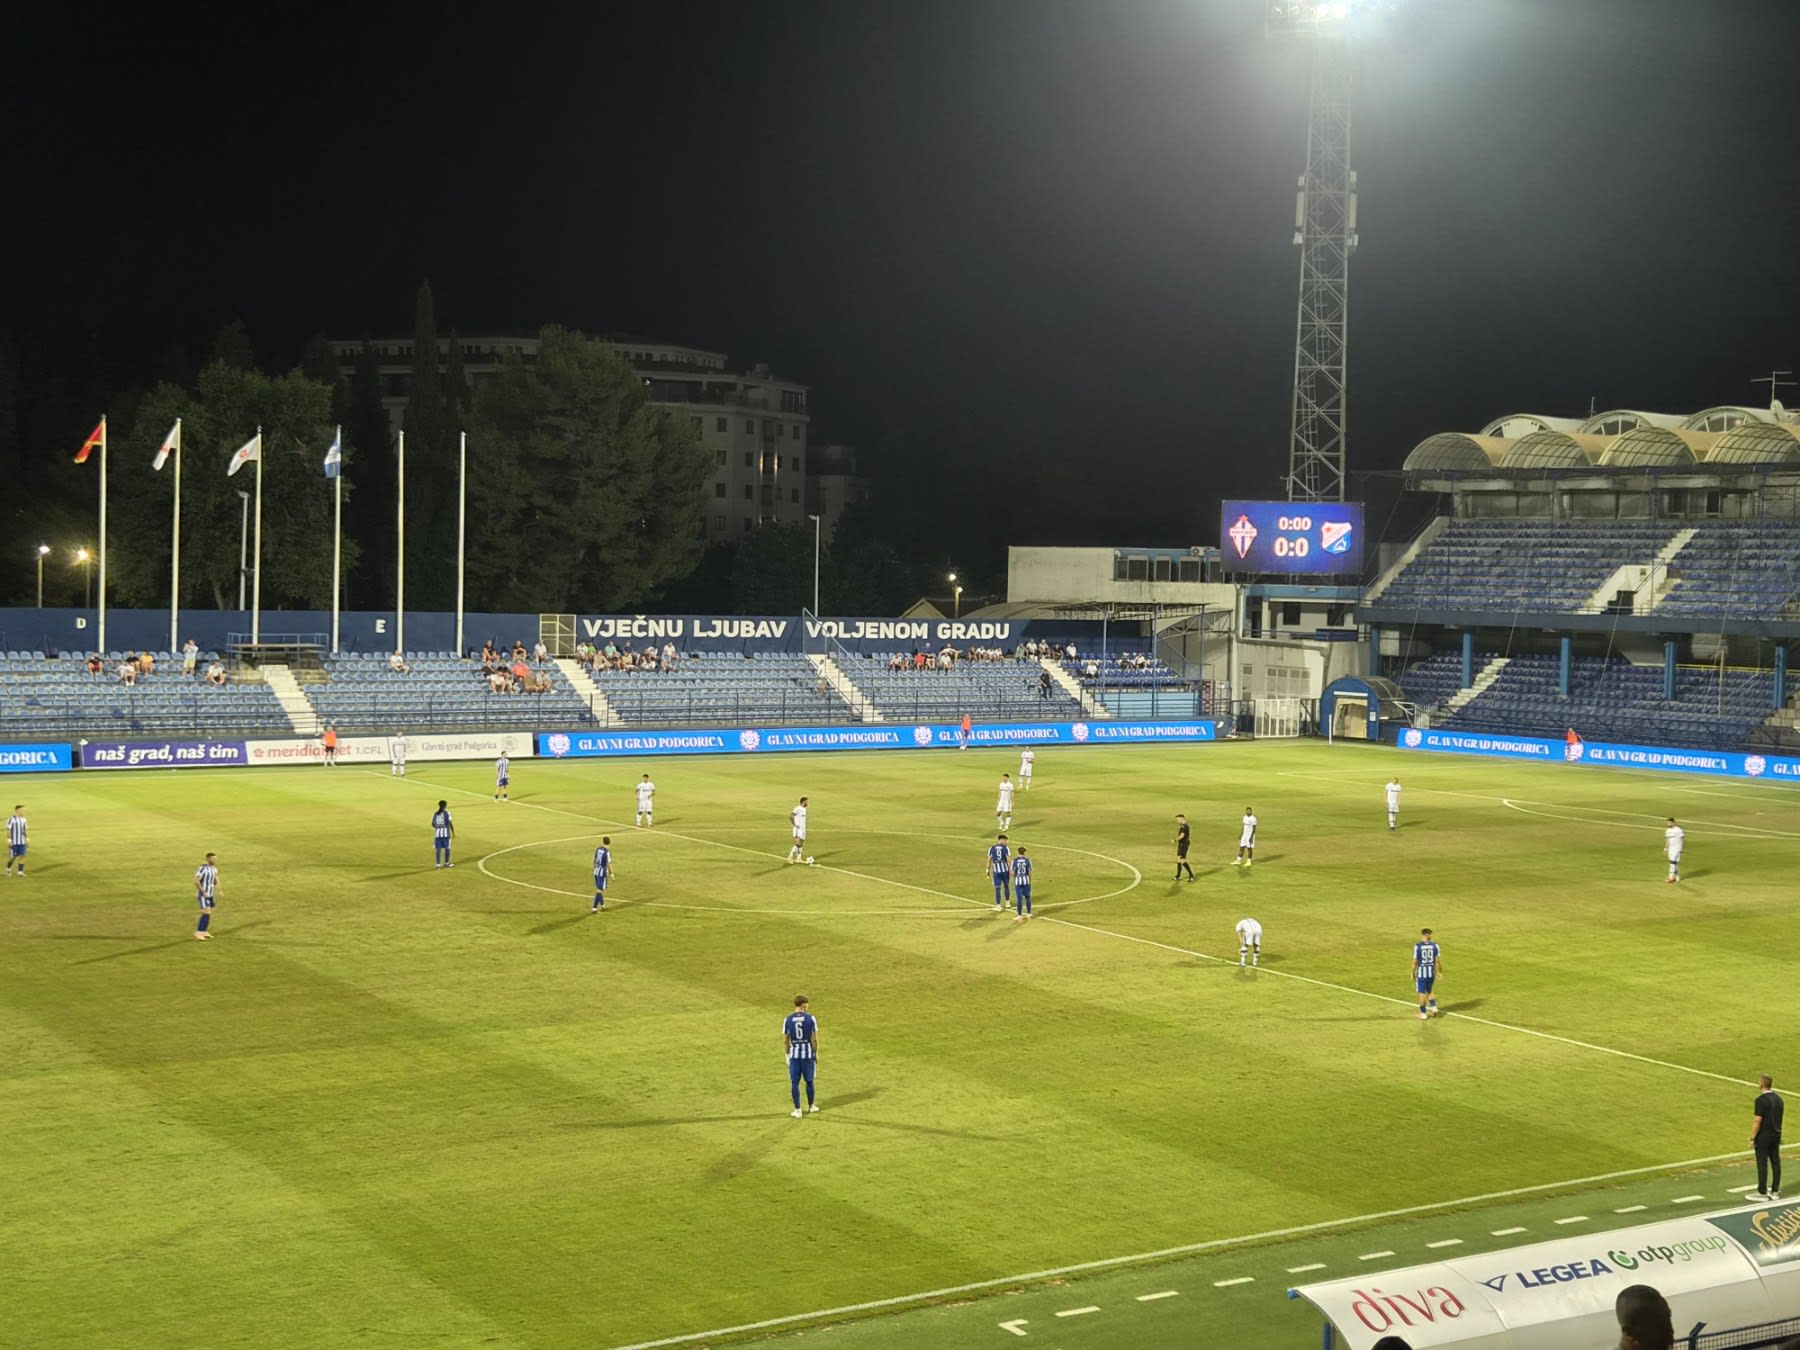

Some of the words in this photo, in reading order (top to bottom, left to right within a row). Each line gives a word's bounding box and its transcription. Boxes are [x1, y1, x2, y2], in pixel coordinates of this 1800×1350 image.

[1279, 517, 1312, 531] 0:00
[1275, 537, 1309, 557] 0:0
[76, 617, 86, 630] D
[376, 619, 386, 633] E
[583, 615, 683, 638] VJEČNU
[693, 620, 787, 638] LJUBAV
[805, 621, 928, 639] VOLJENOM
[937, 622, 1010, 640] GRADU
[767, 734, 806, 746] GLAVNI
[808, 733, 839, 744] GRAD
[840, 732, 899, 743] PODGORICA
[977, 729, 1003, 740] GRAD
[1003, 728, 1060, 740] PODGORICA
[1095, 727, 1130, 738] GLAVNI
[1131, 726, 1155, 737] GRAD
[1155, 726, 1207, 736] PODGORICA
[578, 738, 622, 750] GLAVNI
[625, 737, 657, 748] GRAD
[659, 736, 724, 748] PODGORICA
[1427, 736, 1463, 748] GLAVNI
[1464, 738, 1490, 750] GRAD
[1492, 741, 1550, 755] PODGORICA
[95, 745, 125, 761] naš
[128, 745, 173, 764] grad,
[176, 744, 206, 760] naš
[209, 744, 238, 759] tim
[1590, 748, 1630, 762] GLAVNI
[1631, 752, 1660, 764] GRAD
[1662, 754, 1728, 770] PODGORICA
[1421, 949, 1434, 964] 99
[794, 1022, 804, 1040] 6
[1515, 1258, 1613, 1289] LEGEA
[1349, 1286, 1467, 1333] diva
